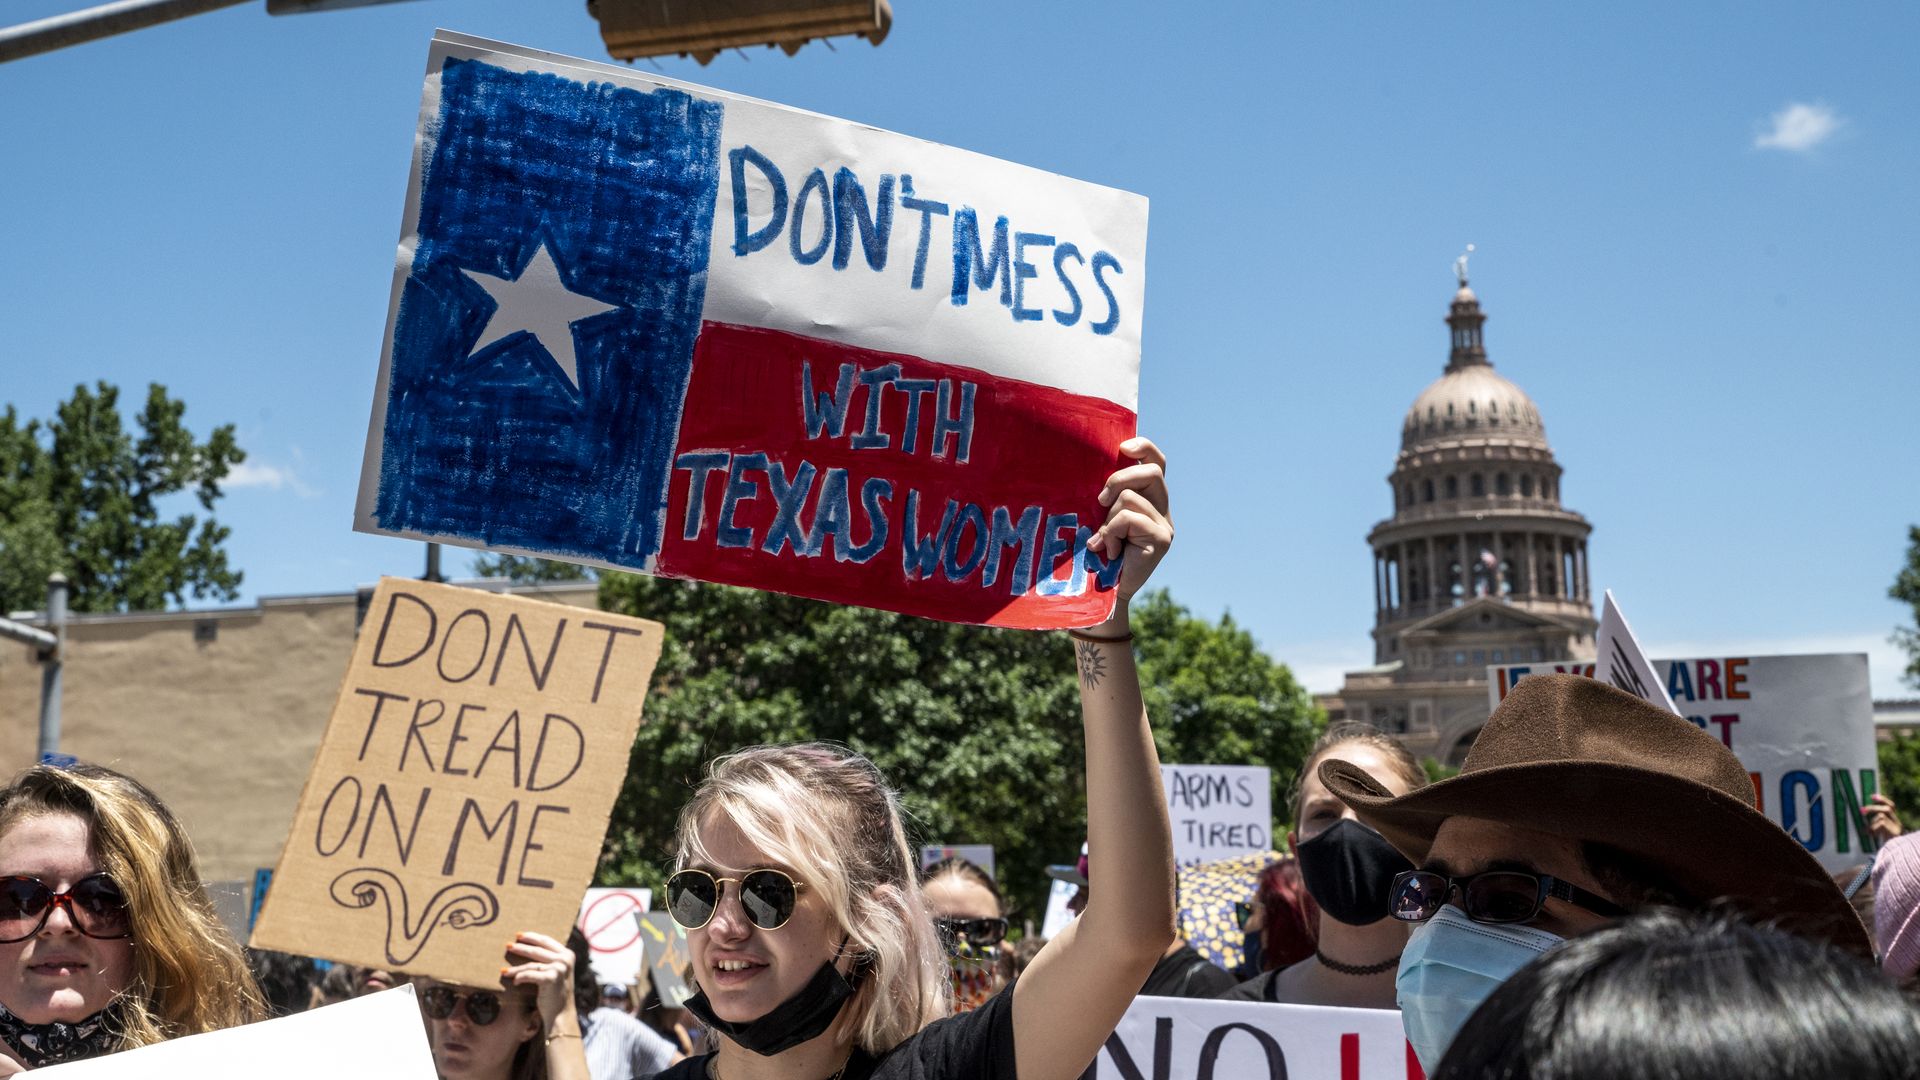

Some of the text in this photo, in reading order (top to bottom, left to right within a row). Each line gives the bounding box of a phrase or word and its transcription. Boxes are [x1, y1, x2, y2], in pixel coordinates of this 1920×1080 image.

[729, 145, 1124, 336] DON'T MESS
[801, 359, 978, 465] WITH
[675, 449, 1123, 597] TEXAS WOMEN
[1668, 658, 1751, 702] ARE
[355, 688, 586, 792] TREAD
[1170, 770, 1254, 811] ARMS
[315, 775, 570, 889] ON ME
[1182, 819, 1266, 849] TIRED
